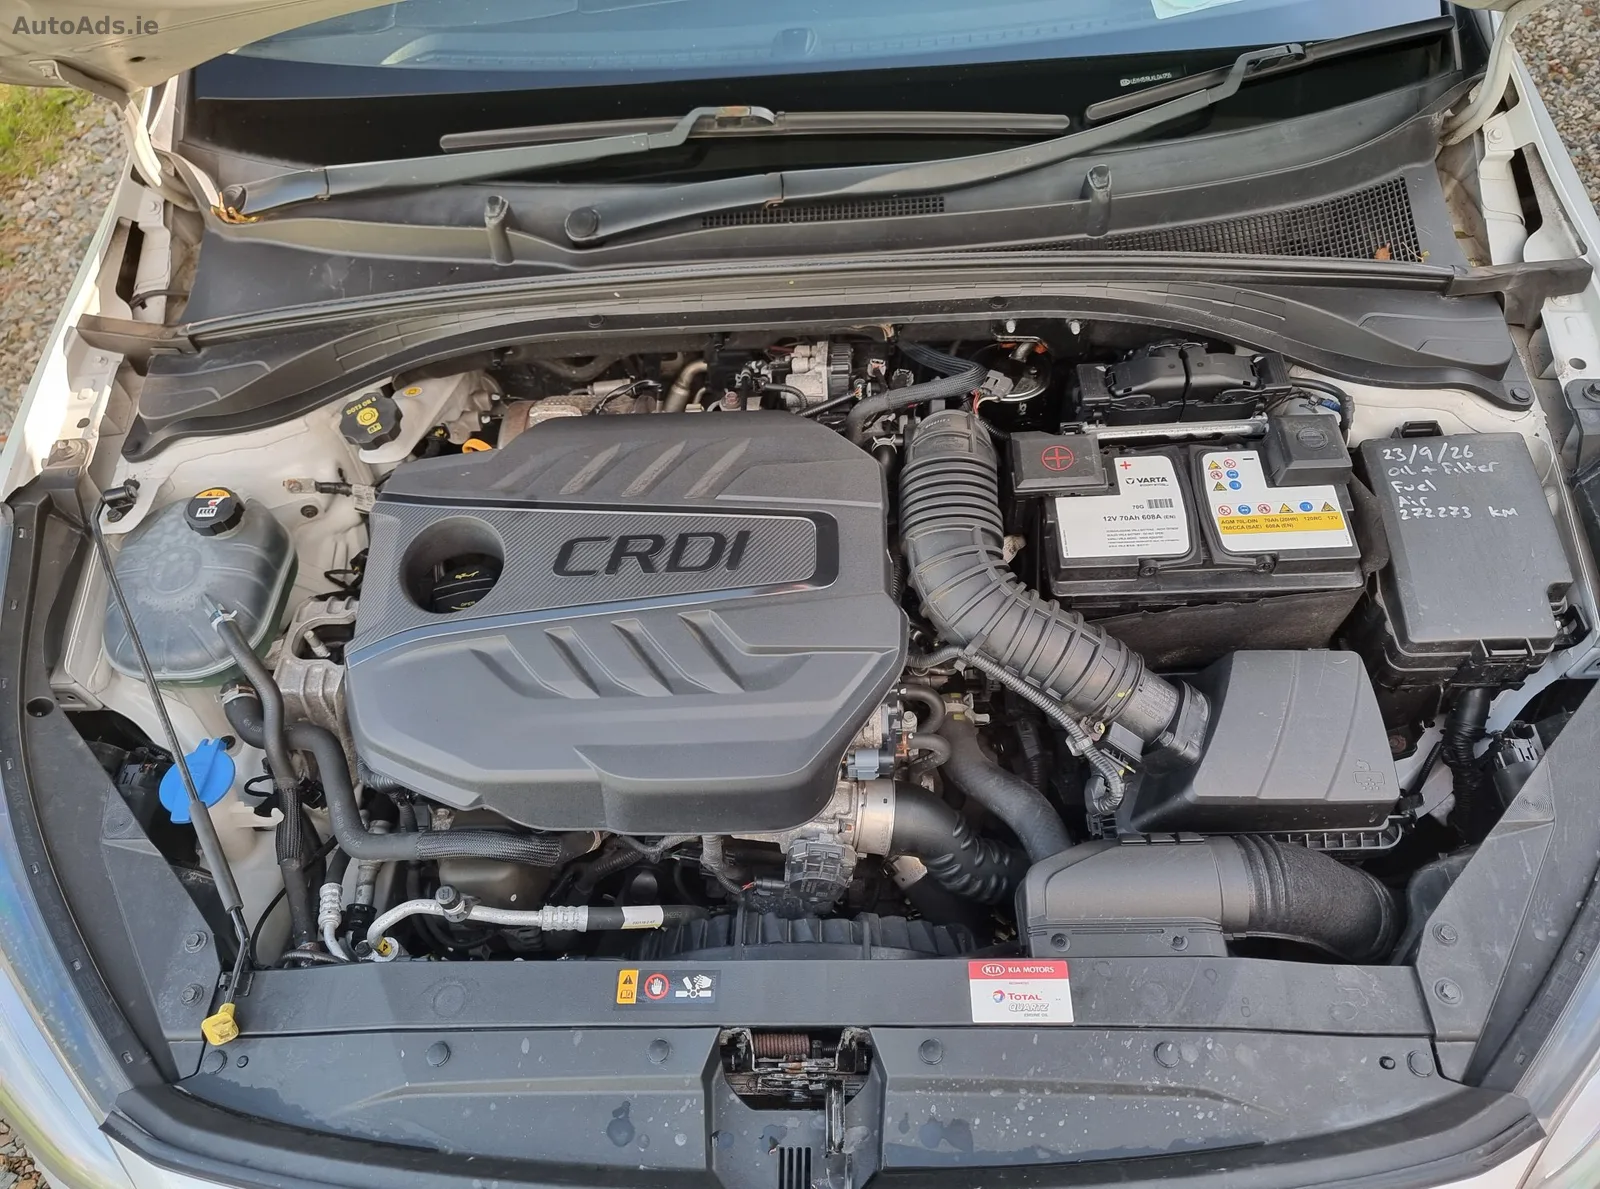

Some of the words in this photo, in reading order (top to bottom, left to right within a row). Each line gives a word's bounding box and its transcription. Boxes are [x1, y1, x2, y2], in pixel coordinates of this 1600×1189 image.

[1383, 442, 1474, 464] 23/9/26
[1391, 479, 1437, 493] Fuel
[1398, 495, 1428, 508] Air
[1400, 505, 1472, 520] 272273
[553, 530, 751, 578] CRDI
[1007, 992, 1042, 1001] TOTAL
[1008, 1002, 1049, 1012] QUARTZ
